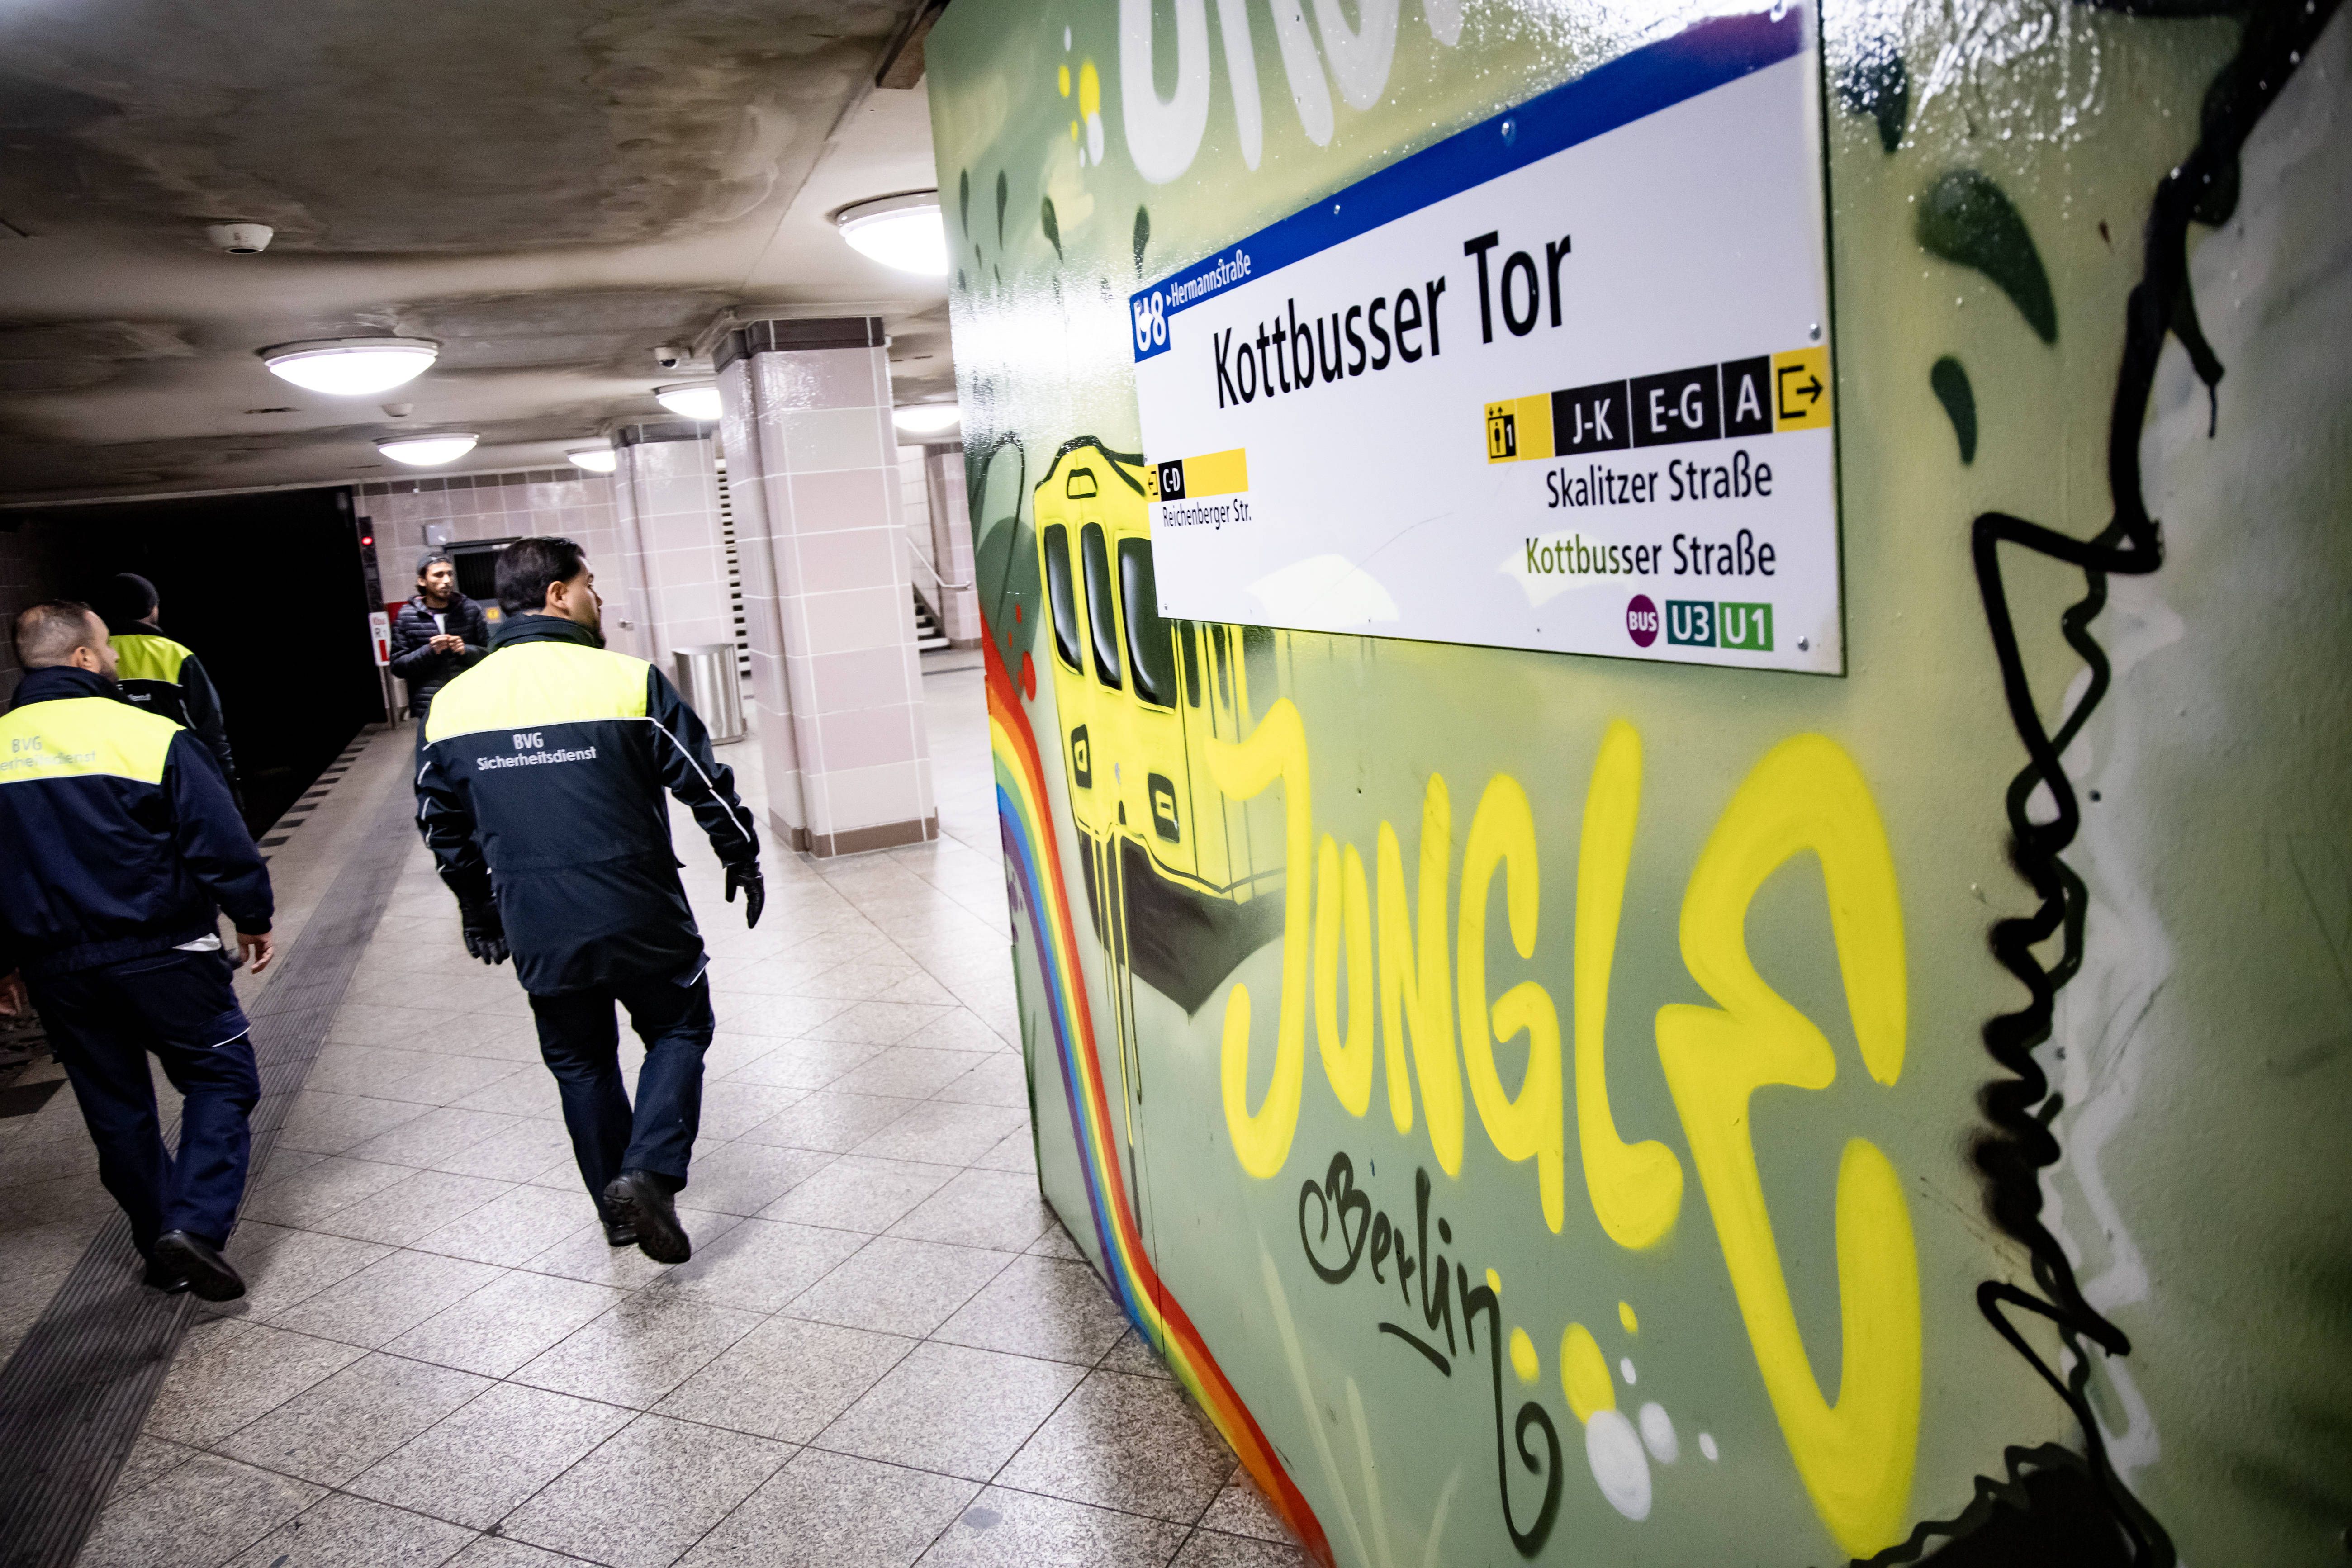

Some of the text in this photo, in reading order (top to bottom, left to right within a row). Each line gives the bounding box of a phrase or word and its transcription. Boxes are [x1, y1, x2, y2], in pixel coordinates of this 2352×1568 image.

[1133, 248, 1251, 352] U8 Hermannstraße
[1213, 230, 1571, 409] Kottbusser Tor
[1506, 374, 1762, 447] 1 J-K E-G A
[1162, 467, 1181, 493] C-D
[1546, 450, 1773, 508] Skalitzer Straße
[1162, 498, 1252, 530] Reichenberger Str.
[1526, 528, 1776, 576] Kottbusser Straße
[1628, 605, 1765, 645] BUS U3 U1
[12, 735, 42, 753] BVG
[476, 746, 597, 771] Sicherheitsdienst
[512, 732, 544, 750] BVG
[1204, 698, 1923, 1560] JUNGLE
[1299, 1151, 1563, 1559] Berlin
